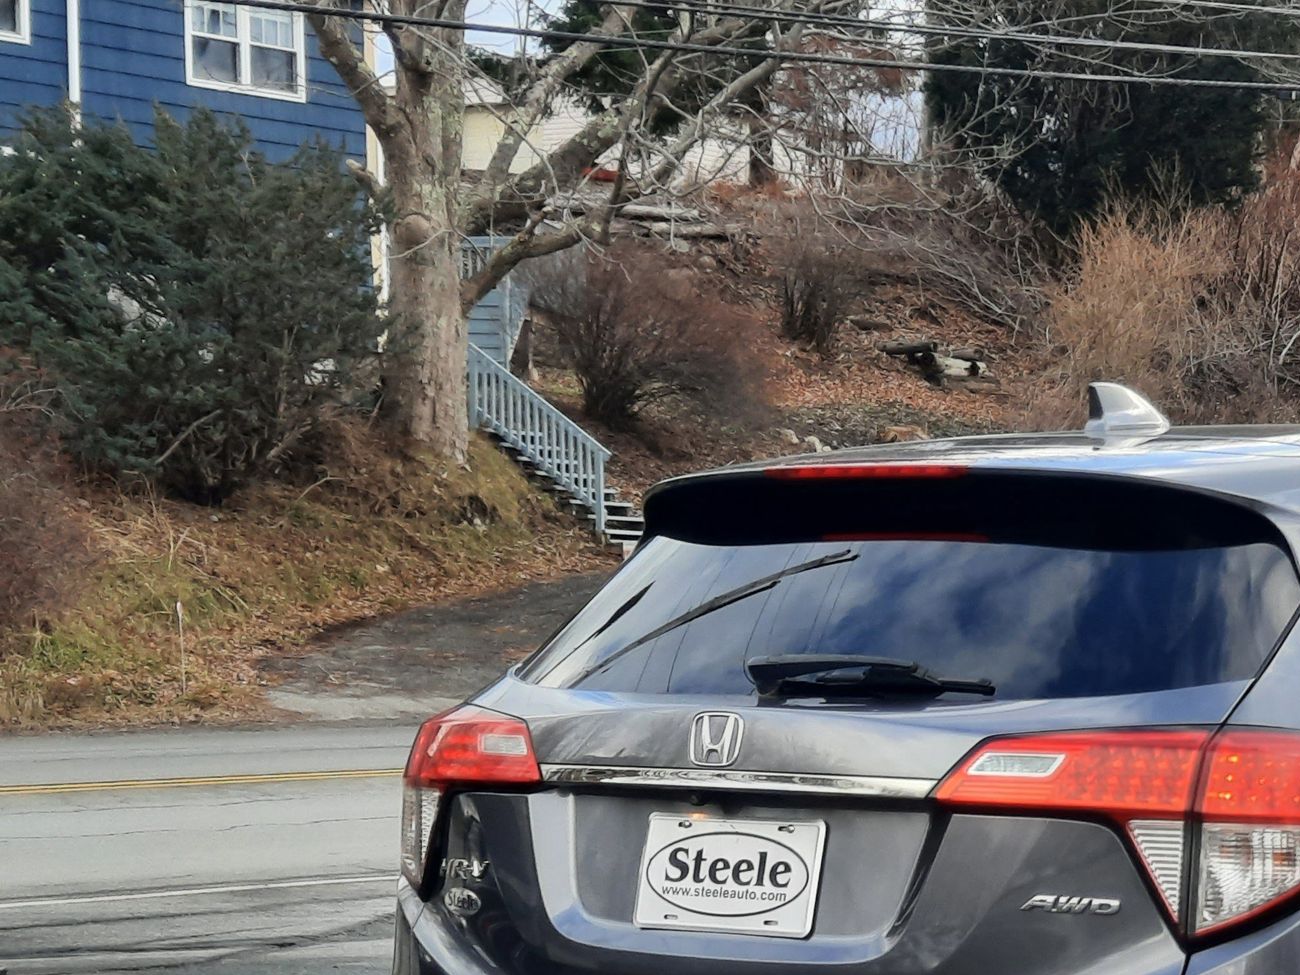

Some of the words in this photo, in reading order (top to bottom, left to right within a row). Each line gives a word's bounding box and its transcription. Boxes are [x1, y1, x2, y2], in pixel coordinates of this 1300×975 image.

[664, 846, 793, 889] Steele
[661, 885, 788, 903] www.steeleauto.com
[1019, 893, 1121, 916] AWD
